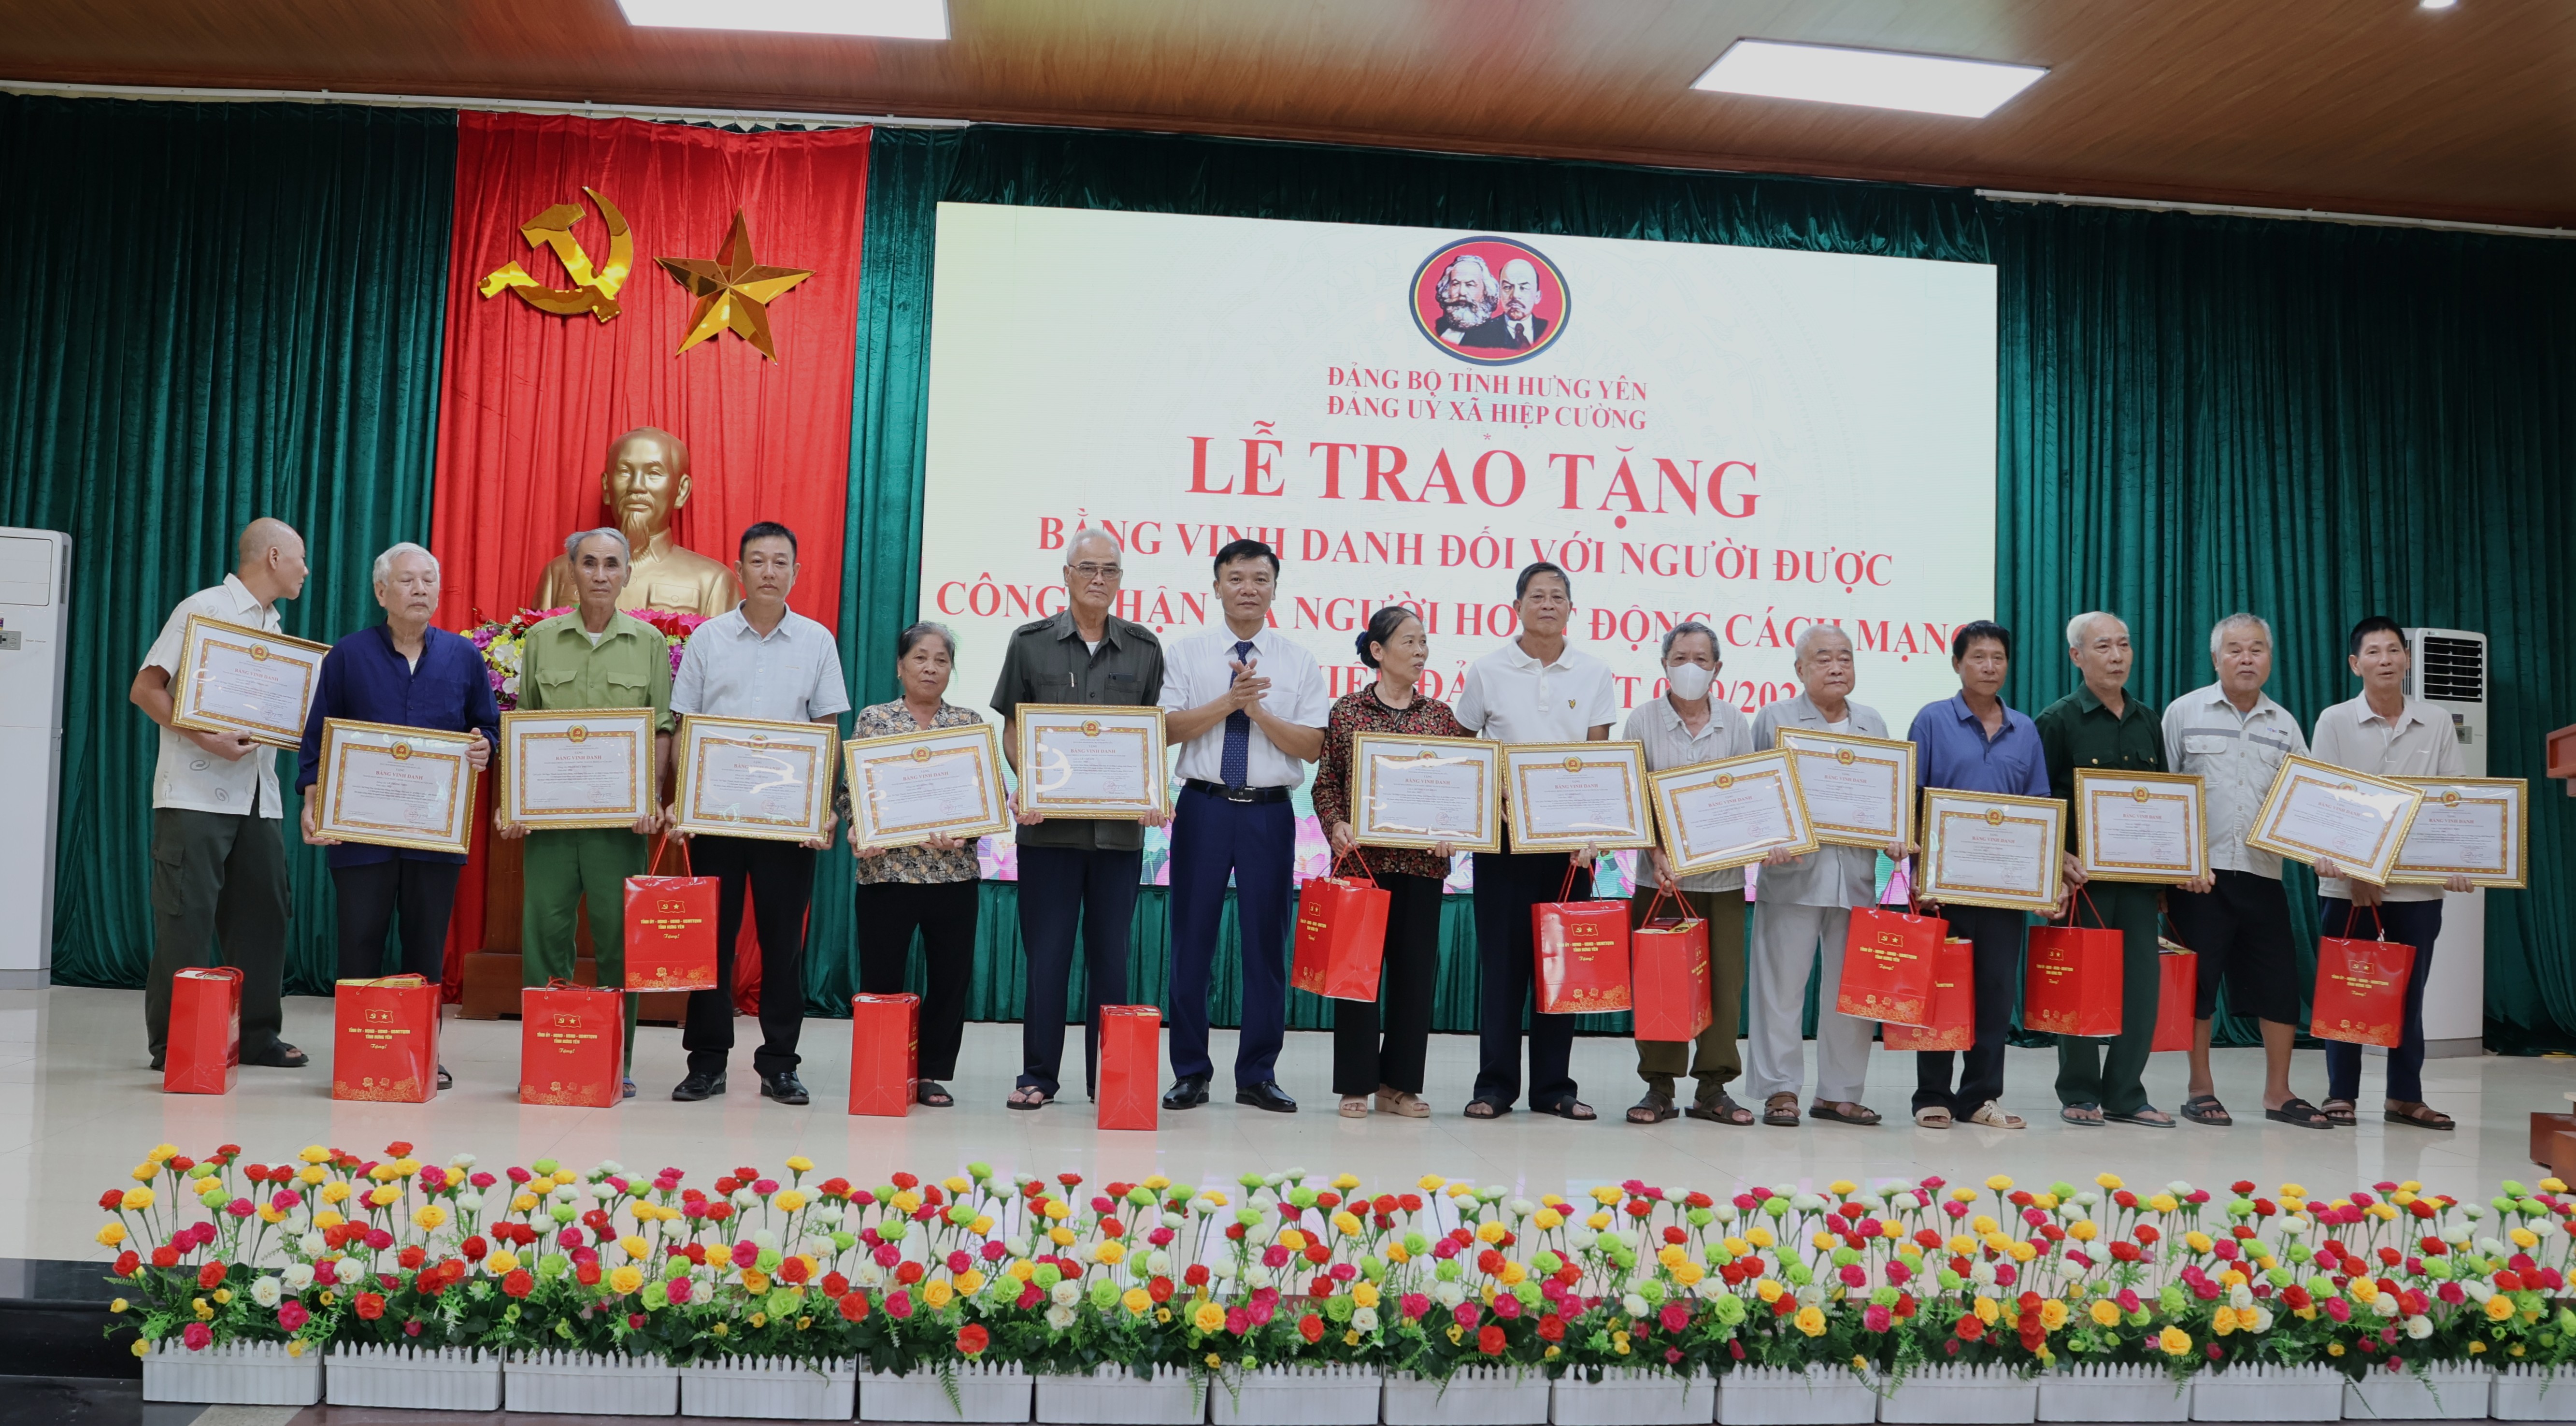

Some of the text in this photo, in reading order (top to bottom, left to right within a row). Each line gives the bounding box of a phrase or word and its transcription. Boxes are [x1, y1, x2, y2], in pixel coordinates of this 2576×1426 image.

[1327, 362, 1647, 401] ĐẢNG BỘ TỈNH HƯNG YÊN
[1327, 390, 1399, 418] ĐẢNG
[1449, 397, 1484, 422] XÃ
[1491, 403, 1549, 429] HIỆP
[1555, 403, 1646, 430] CƯỜNG
[1186, 420, 1760, 529] LỄ TRAO TẶNG
[1300, 529, 1425, 566] DANH
[1437, 526, 1517, 569] ĐỐI
[1529, 531, 1606, 573] VỚI
[1620, 537, 1760, 580] NGƯỜI
[1773, 546, 1892, 593] ĐƯỢC
[936, 572, 1066, 618] CÔNG
[1116, 585, 1209, 634] HẬN
